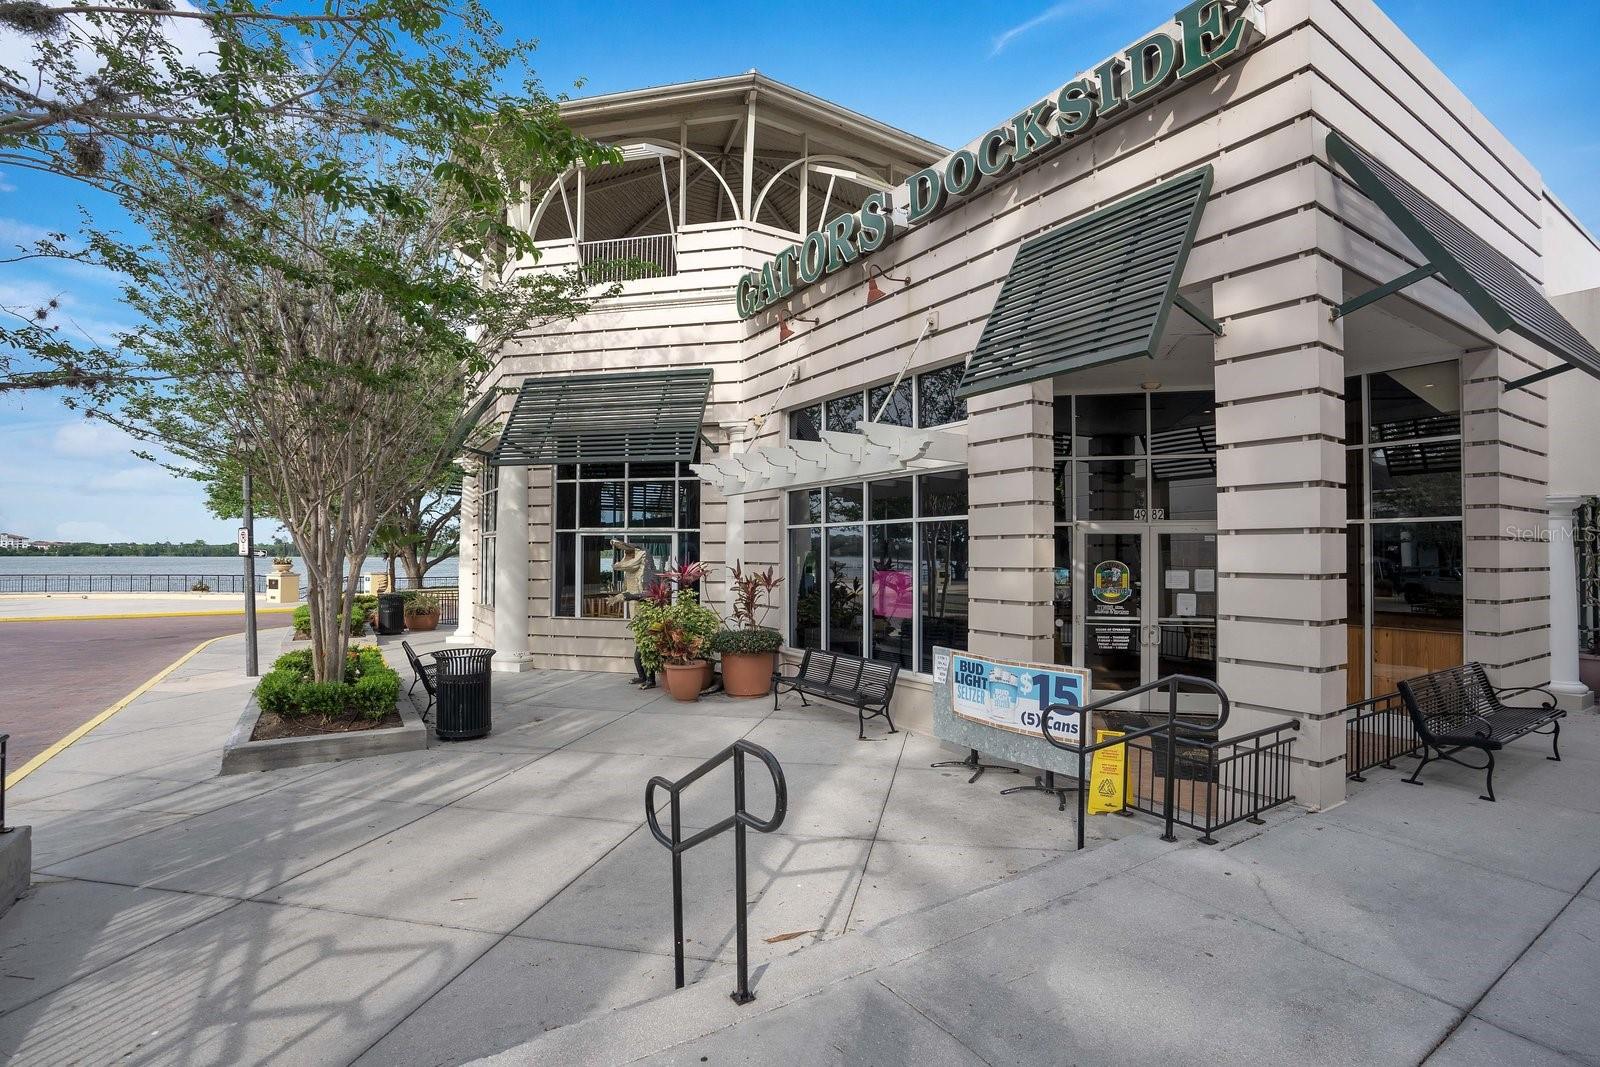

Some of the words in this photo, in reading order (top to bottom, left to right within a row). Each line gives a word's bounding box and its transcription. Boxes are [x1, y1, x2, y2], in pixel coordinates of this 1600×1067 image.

[736, 192, 889, 319] GATORS
[906, 0, 1247, 223] DOCKSIDE
[959, 659, 984, 676] BUD
[955, 671, 988, 690] LIGHT
[957, 685, 986, 705] SELTZER
[1021, 711, 1041, 728] (5)
[1046, 715, 1079, 734] Cans
